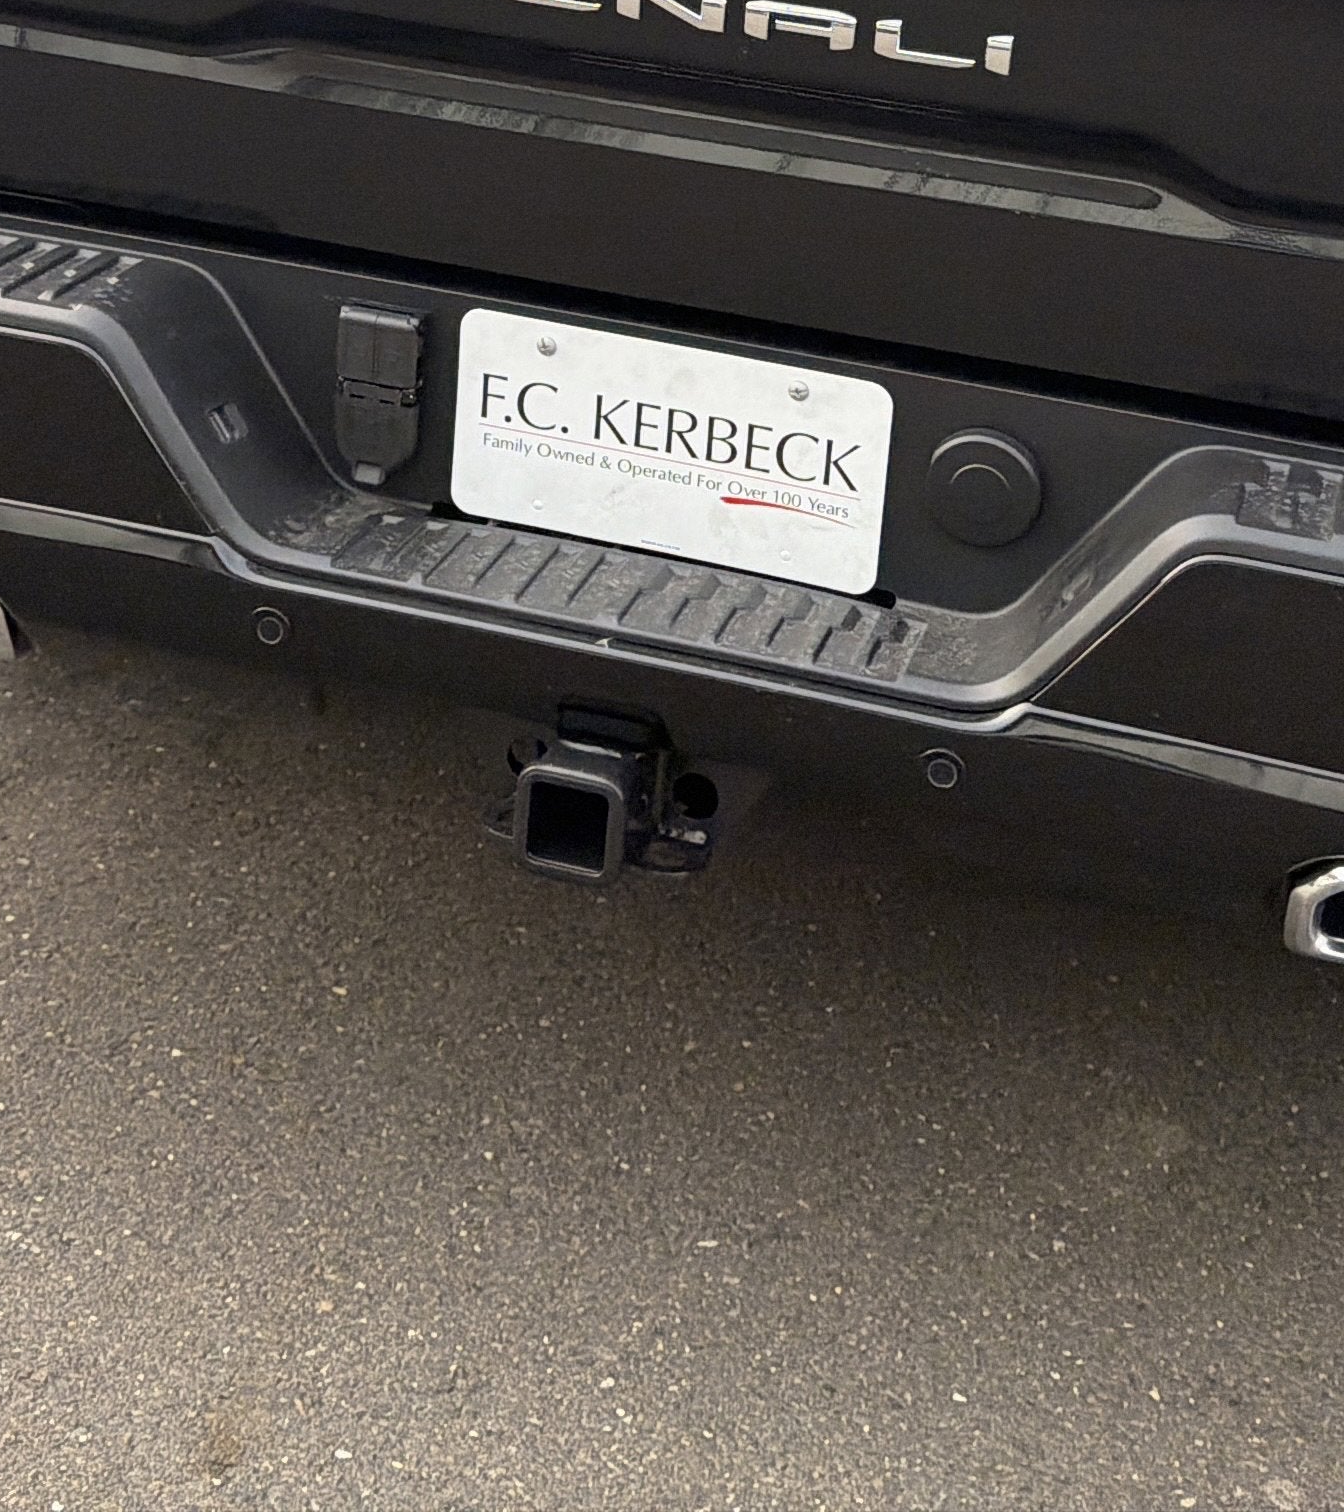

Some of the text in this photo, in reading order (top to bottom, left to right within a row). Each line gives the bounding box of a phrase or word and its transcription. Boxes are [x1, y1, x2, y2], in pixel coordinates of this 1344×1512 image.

[480, 372, 863, 493] F.C. KERBECK
[482, 432, 850, 519] Family Owned & Operated For Over 100 Years
